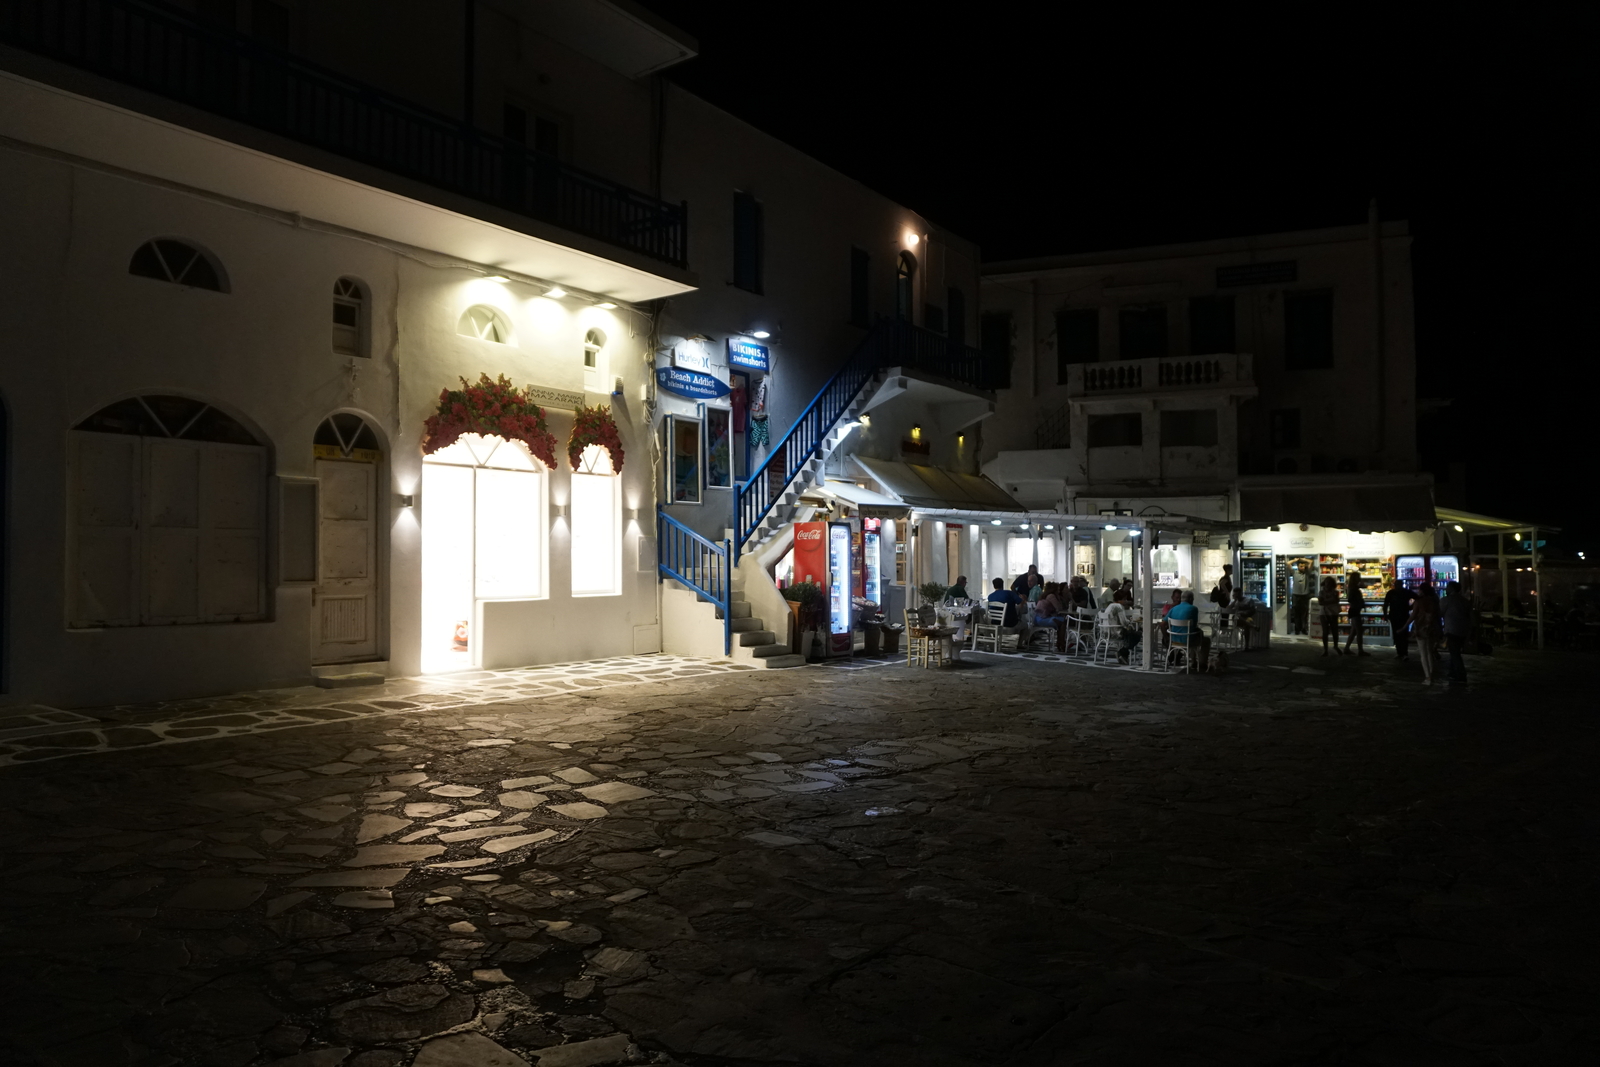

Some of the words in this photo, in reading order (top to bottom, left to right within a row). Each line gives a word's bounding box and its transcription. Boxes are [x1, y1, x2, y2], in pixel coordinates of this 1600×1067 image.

[732, 343, 761, 358] BIKINIS
[678, 351, 701, 366] Hurley
[670, 370, 691, 383] Beach
[692, 375, 715, 388] Addict
[531, 388, 555, 397] ANNA
[667, 380, 684, 390] bikinis
[689, 385, 718, 396] boardshorts
[530, 392, 583, 405] MAZARAKI
